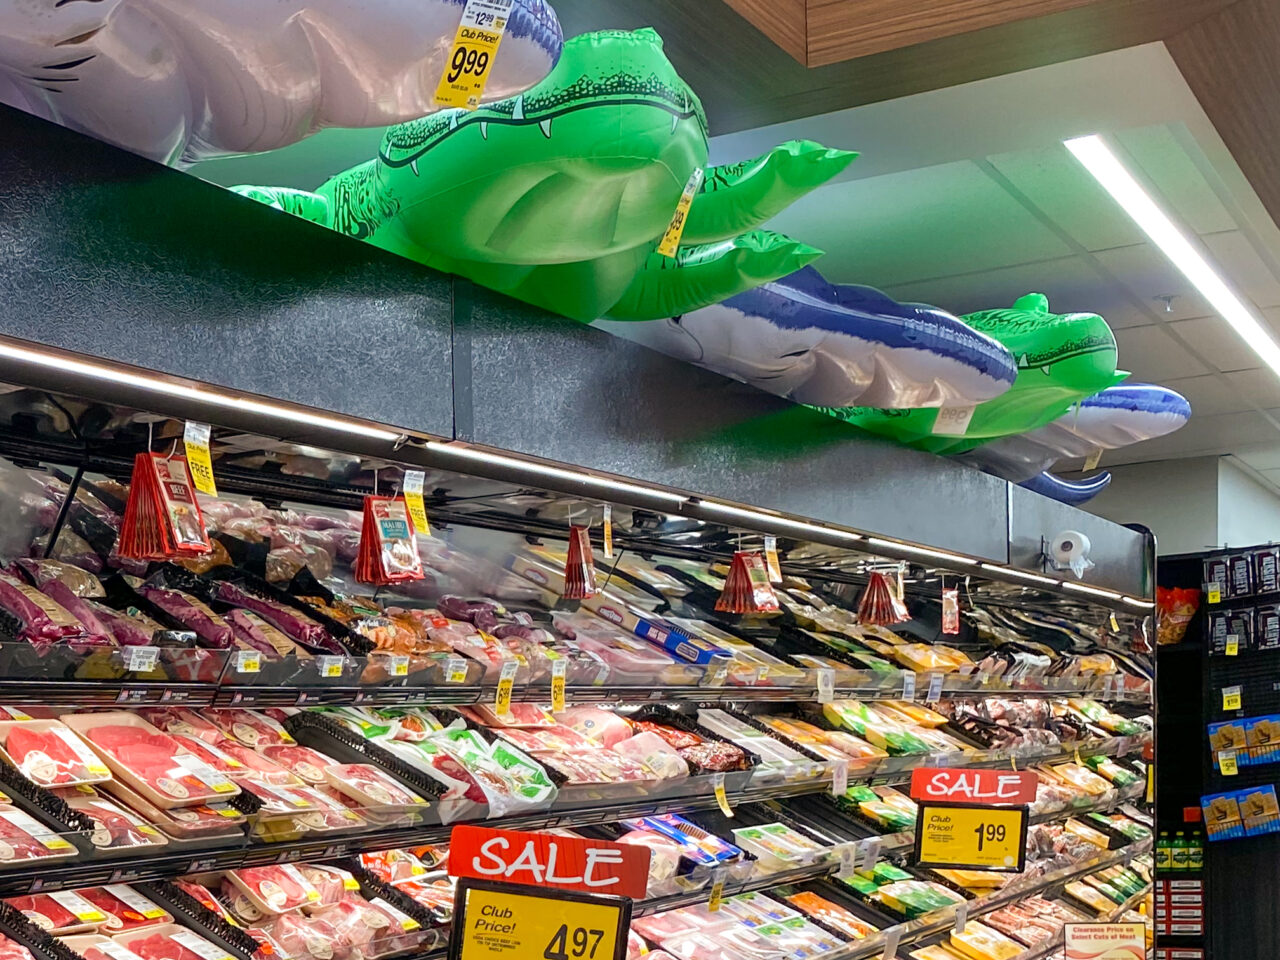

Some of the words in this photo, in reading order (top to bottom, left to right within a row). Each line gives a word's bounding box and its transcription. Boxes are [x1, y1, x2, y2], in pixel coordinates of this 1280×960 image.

[461, 28, 475, 41] Club
[476, 30, 499, 45] Price!
[447, 46, 489, 83] 999
[190, 462, 211, 479] FREE
[169, 484, 185, 495] BEEF
[498, 687, 510, 704] 699
[926, 772, 1022, 798] SALE
[927, 823, 954, 832] Price!
[930, 815, 951, 823] Club
[974, 822, 1006, 852] 199
[472, 836, 624, 887] SALE
[481, 904, 513, 919] Club
[475, 919, 516, 934] Price!
